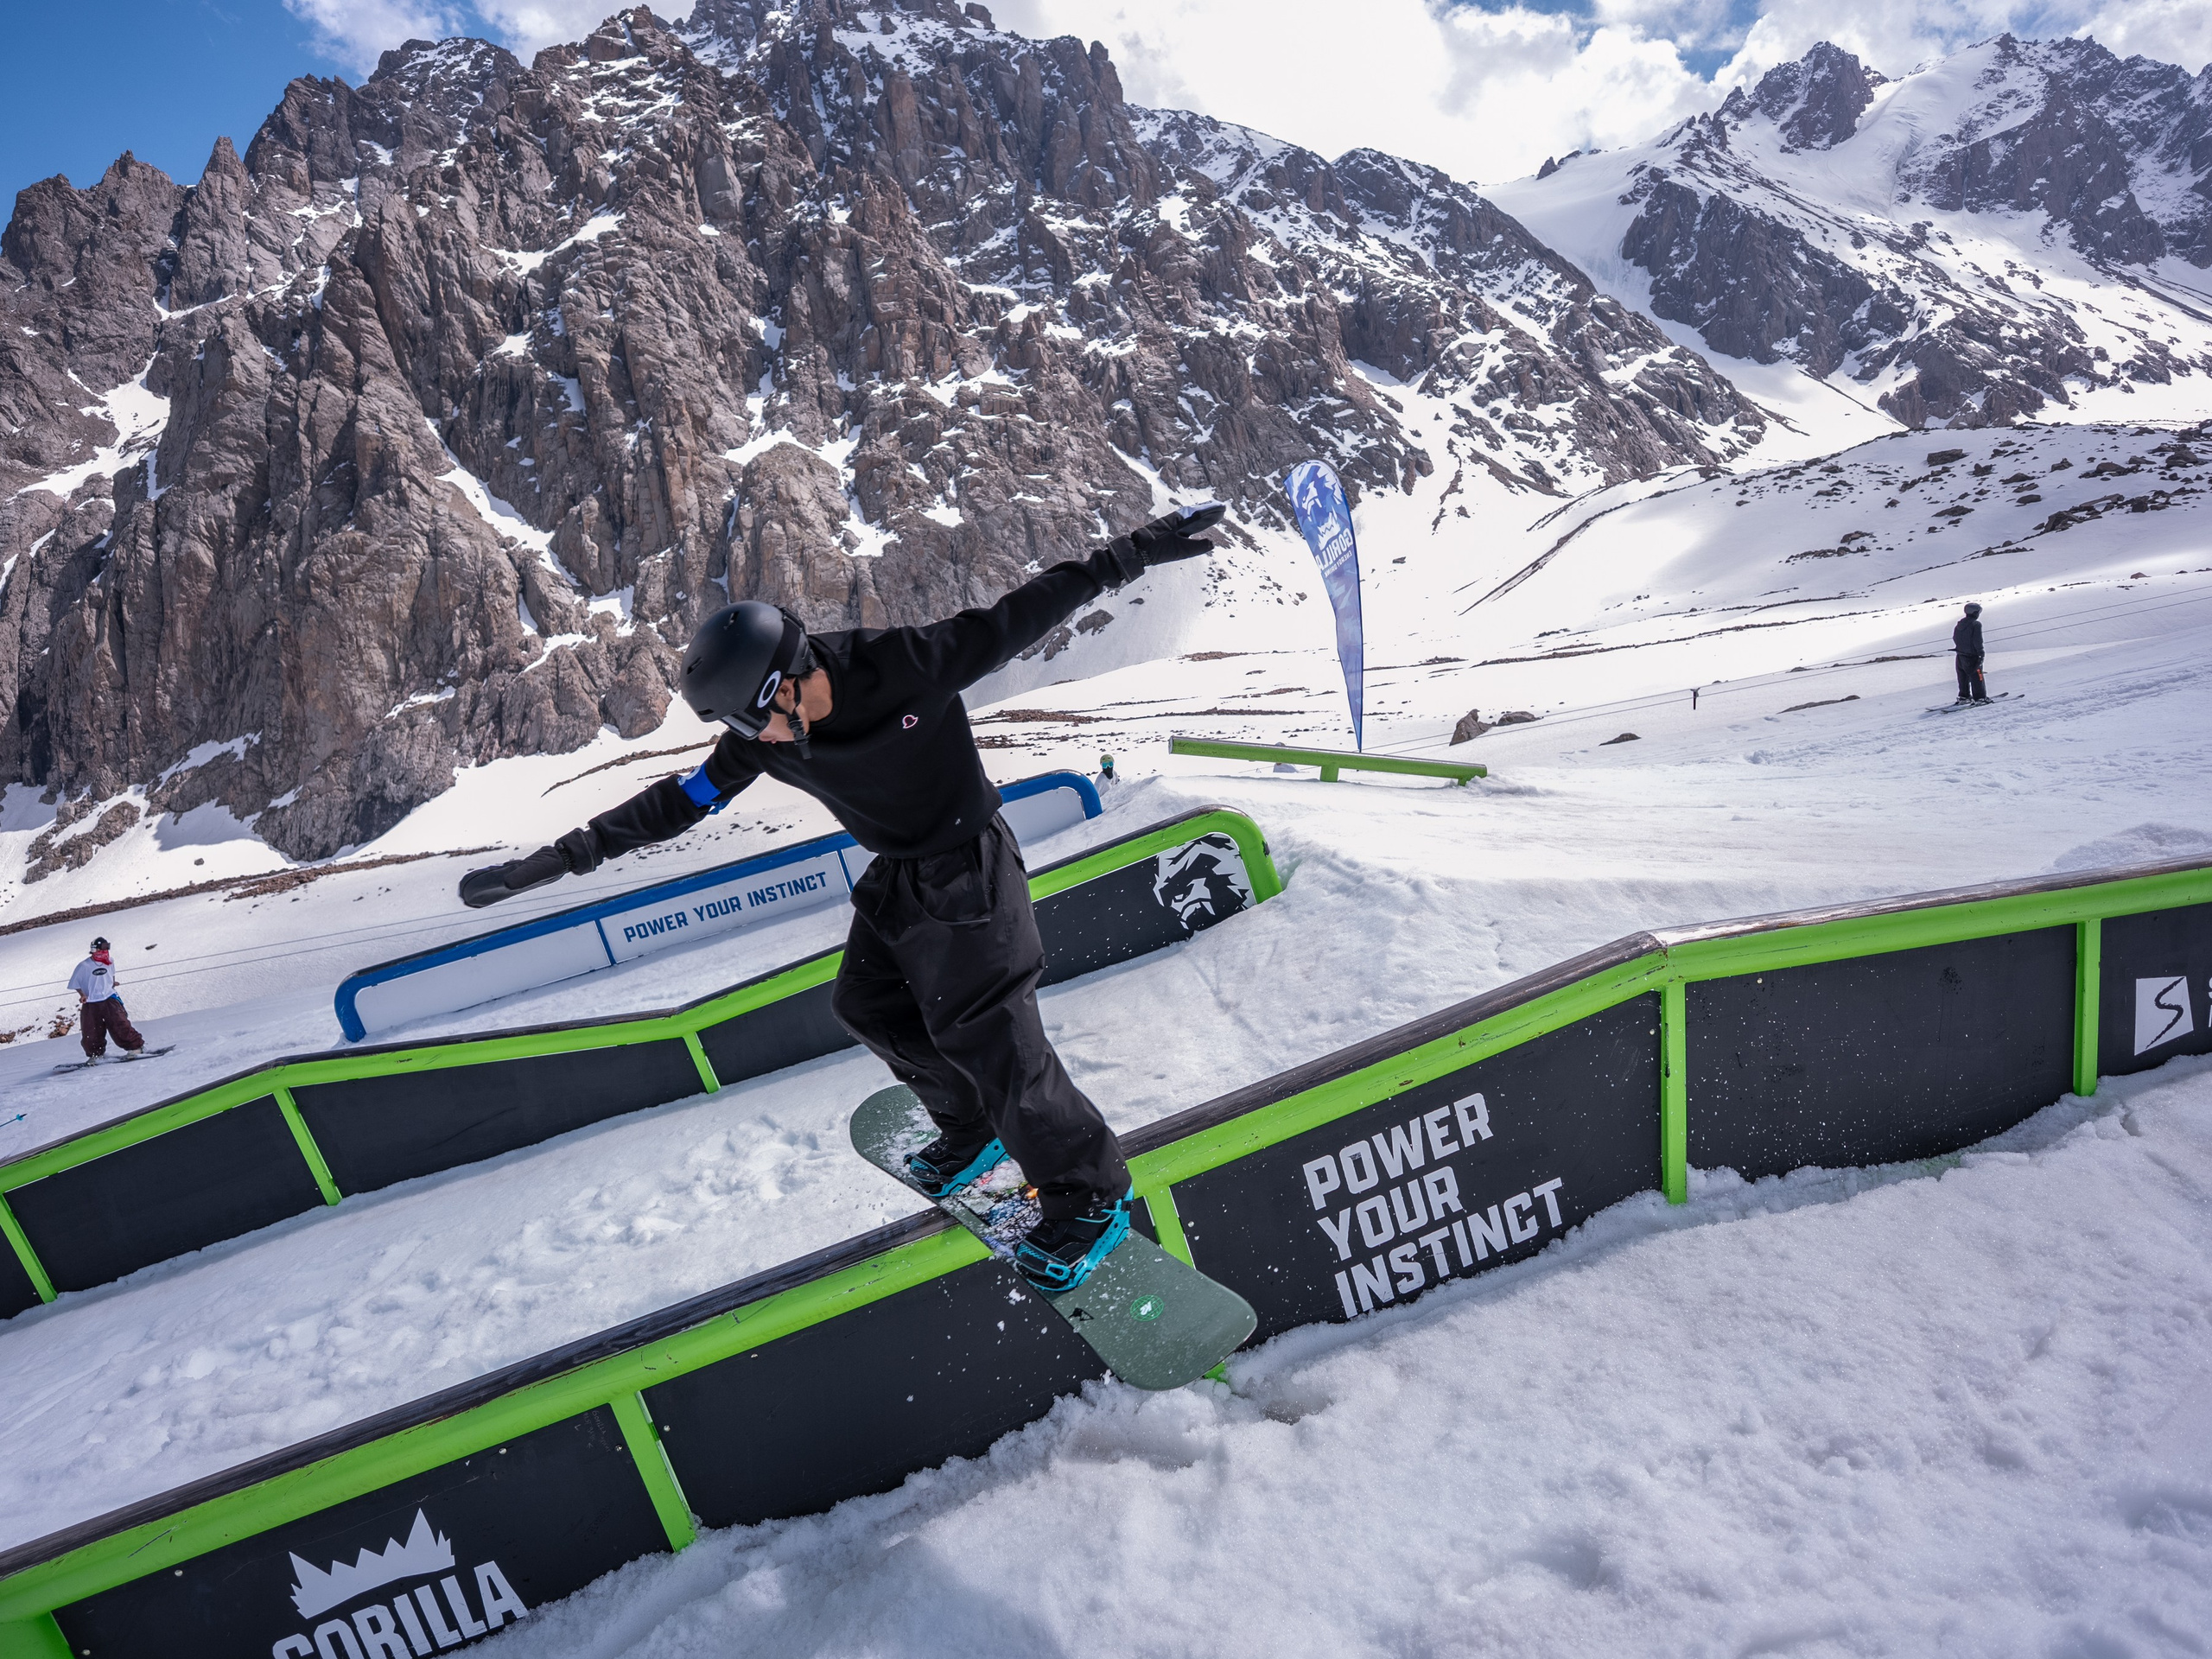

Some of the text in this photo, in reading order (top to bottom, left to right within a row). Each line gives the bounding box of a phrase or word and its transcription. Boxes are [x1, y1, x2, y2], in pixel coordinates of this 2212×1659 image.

[623, 871, 826, 943] POWER YOUR INSTINCT
[1302, 1092, 1494, 1211] POWER
[1317, 1166, 1464, 1262] YOUR
[1334, 1177, 1563, 1319] INSTINCT
